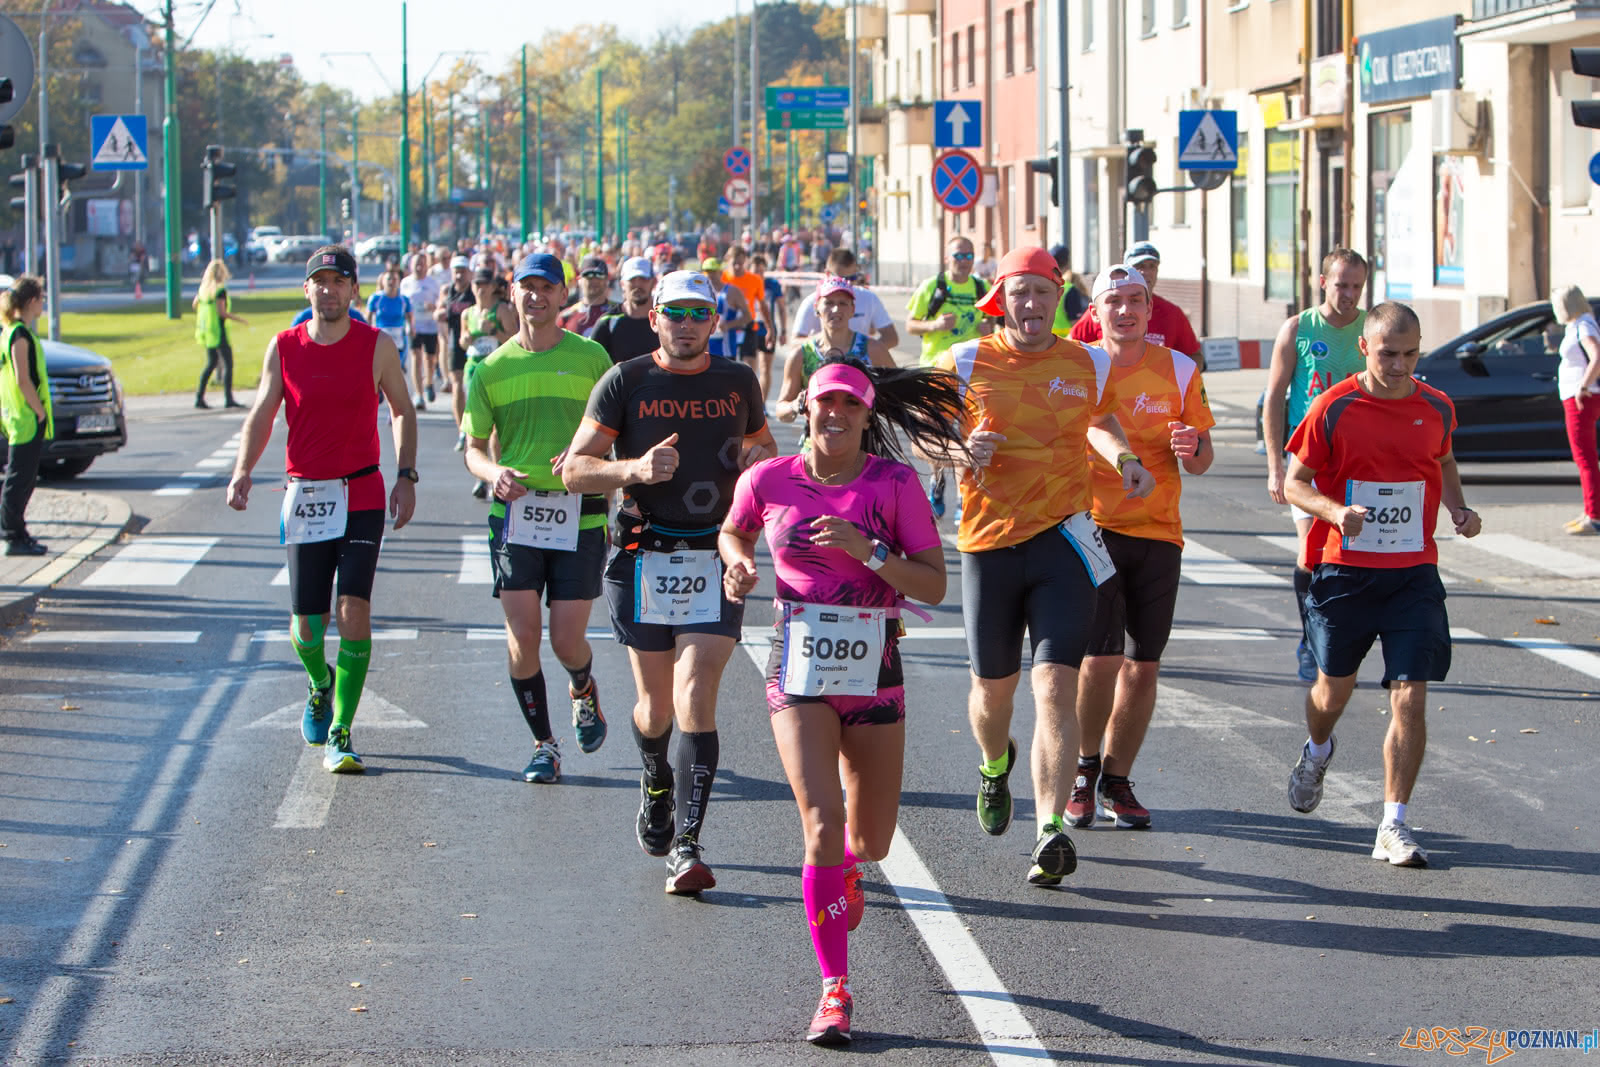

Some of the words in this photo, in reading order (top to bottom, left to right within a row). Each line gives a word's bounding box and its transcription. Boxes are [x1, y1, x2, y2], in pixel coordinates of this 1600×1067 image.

[295, 502, 337, 518] 4337
[523, 505, 567, 525] 5570
[1364, 506, 1412, 524] 3620
[655, 576, 707, 595] 3220
[801, 636, 868, 660] 5080
[815, 664, 848, 672] Dominika
